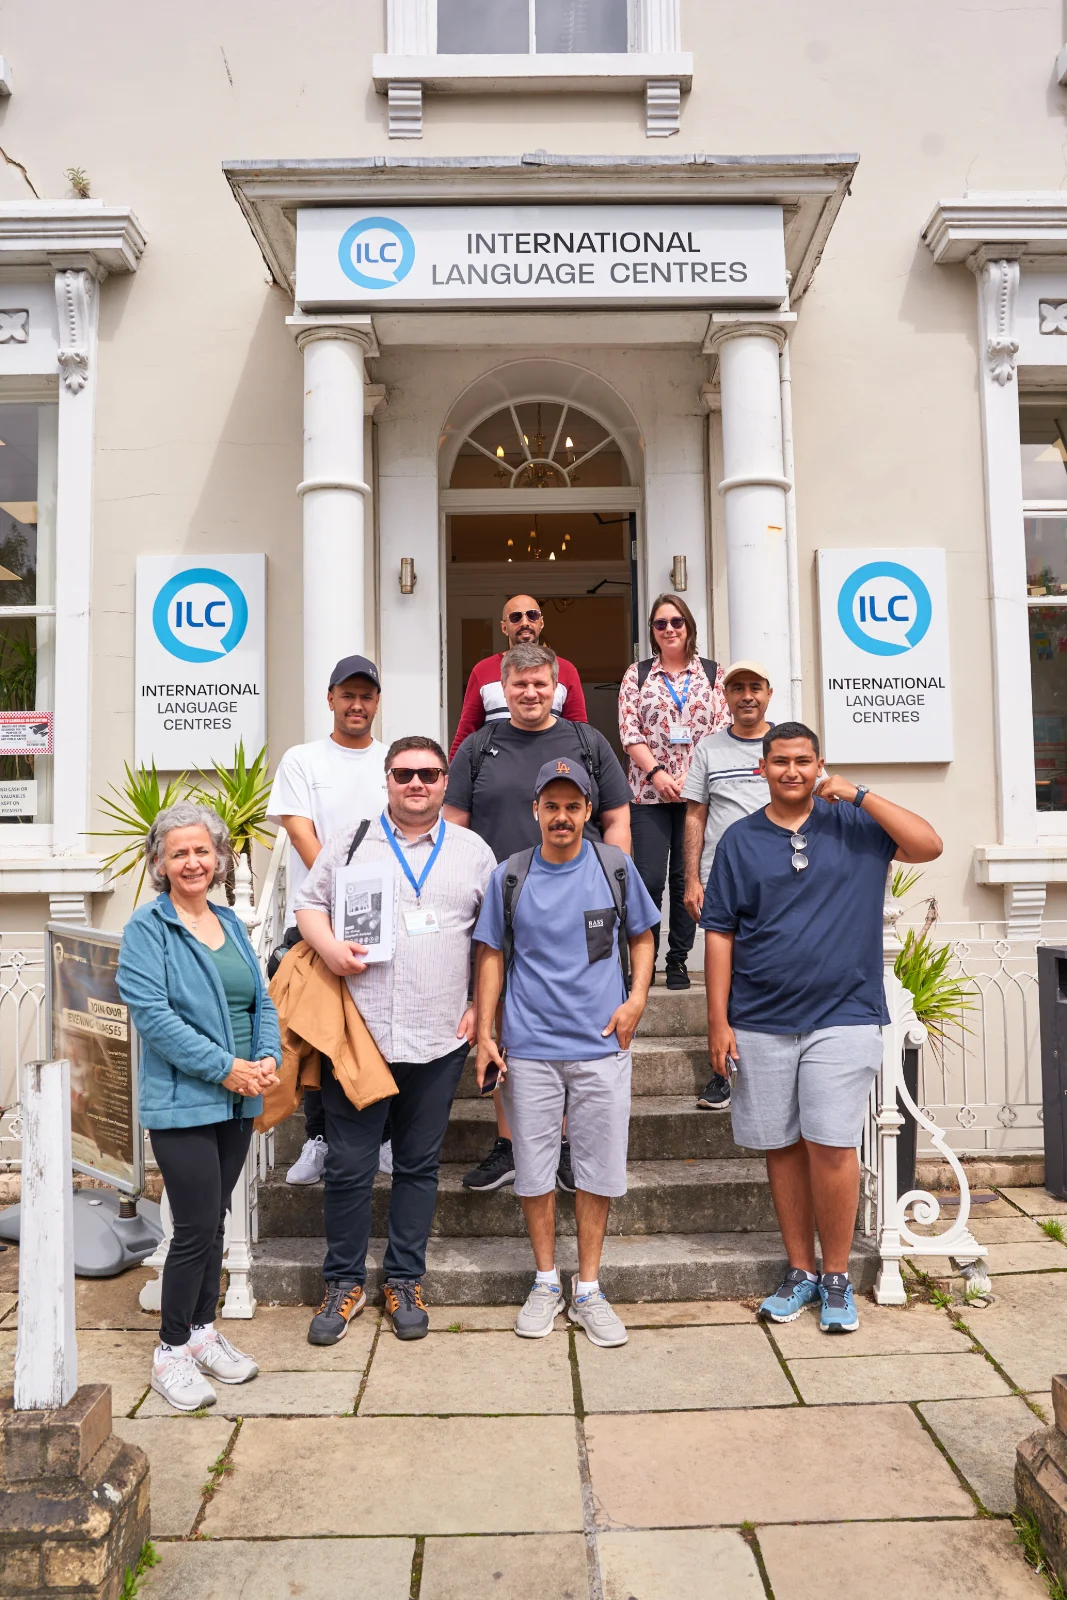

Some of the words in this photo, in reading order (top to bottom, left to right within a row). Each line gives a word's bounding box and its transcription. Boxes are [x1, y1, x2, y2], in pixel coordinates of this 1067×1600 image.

[467, 232, 700, 255] INTERNATIONAL
[357, 242, 397, 264] ILC
[433, 263, 595, 286] LANGUAGE
[610, 262, 748, 284] CENTRES
[176, 601, 226, 627] ILC
[860, 595, 909, 622] ILC
[142, 684, 260, 697] INTERNATIONAL
[829, 677, 946, 691] INTERNATIONAL
[158, 701, 238, 714] LANGUAGE
[846, 694, 926, 707] LANGUAGE
[164, 717, 232, 731] CENTRES
[853, 711, 920, 724] CENTRES
[556, 761, 570, 774] LA
[91, 1002, 105, 1015] JOIN
[105, 1006, 122, 1018] OUR
[68, 1012, 94, 1029] EVENING
[190, 1323, 206, 1331] ILA
